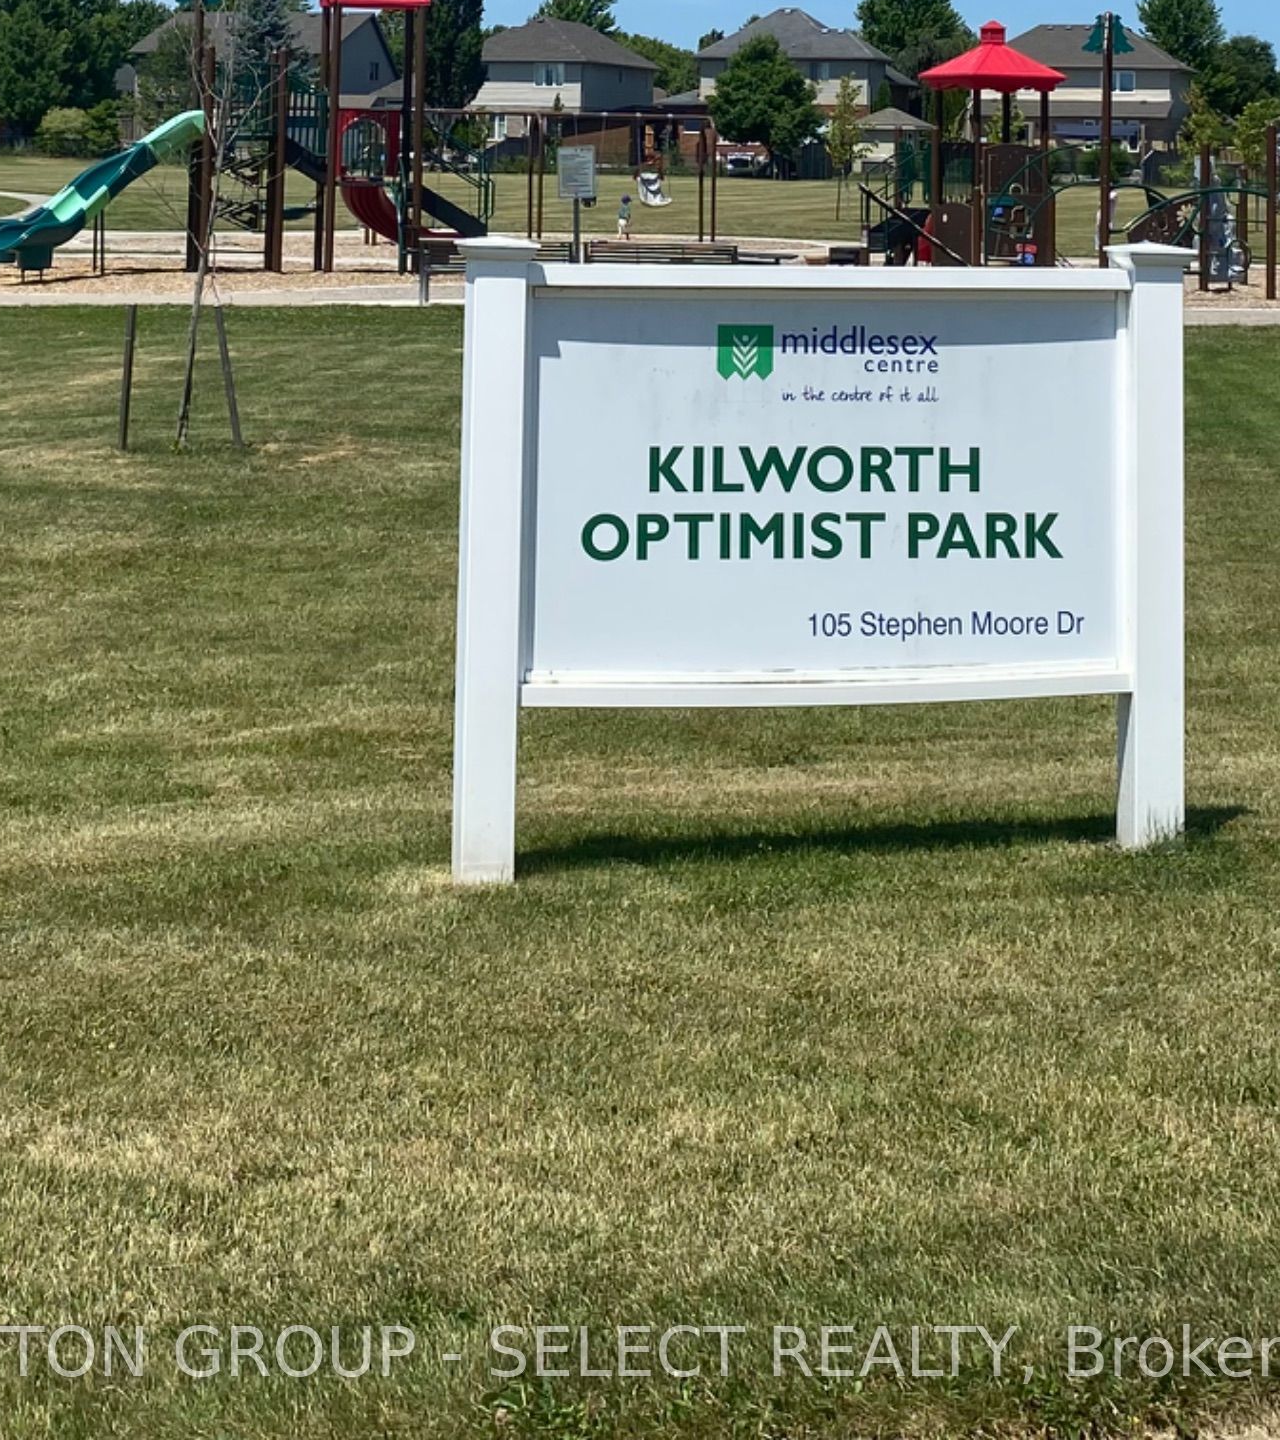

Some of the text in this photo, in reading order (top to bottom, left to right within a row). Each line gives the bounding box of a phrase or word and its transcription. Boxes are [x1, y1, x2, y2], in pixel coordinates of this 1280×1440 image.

[781, 325, 938, 355] middlesex
[864, 359, 939, 373] centre
[782, 385, 939, 406] in the centre of it all
[648, 445, 981, 493] KILWORTH
[580, 511, 1064, 561] OPTIMIST PARK
[808, 610, 1085, 642] 105 Stephen Moore Dr
